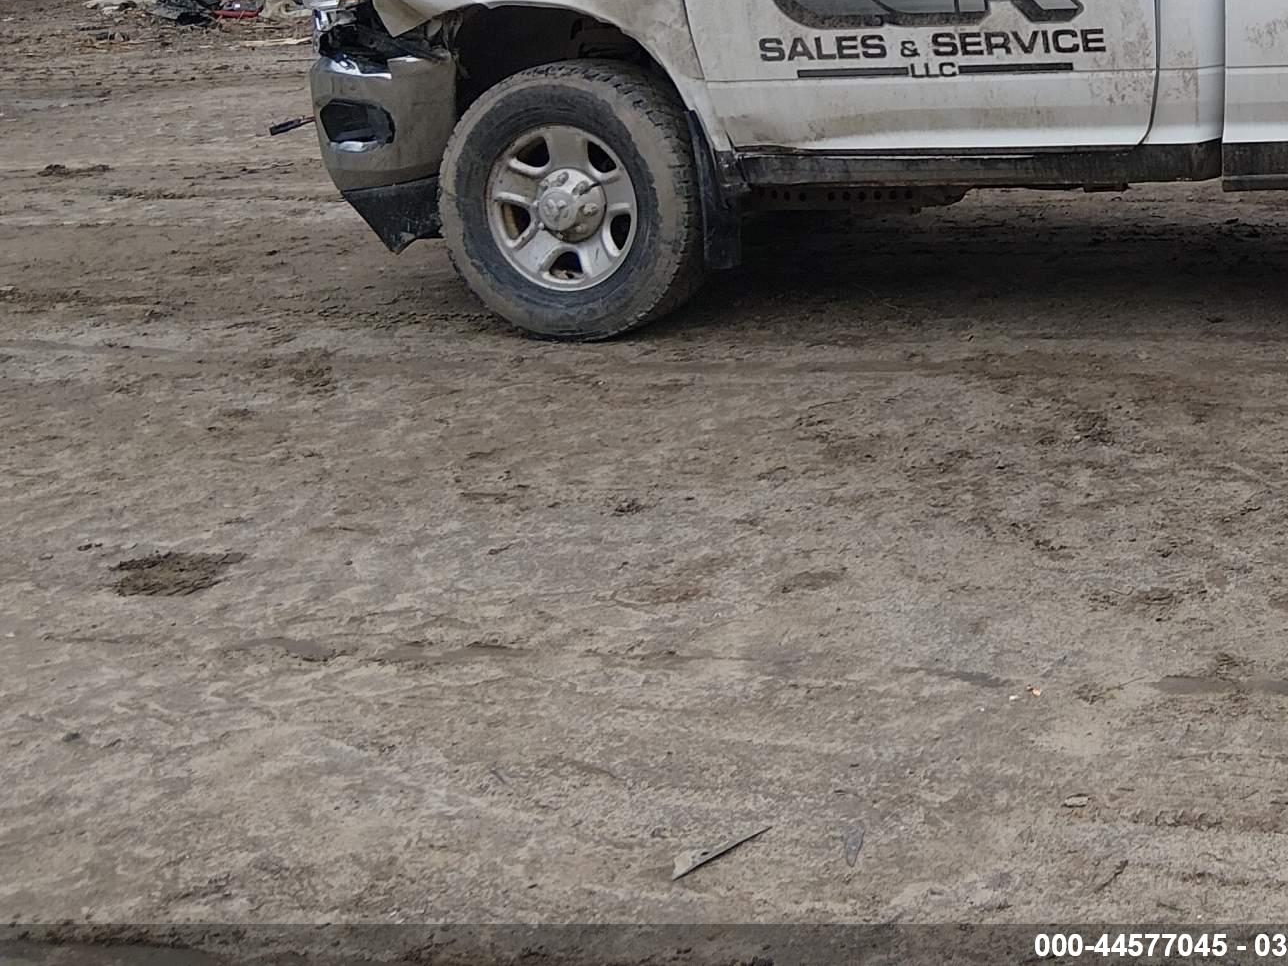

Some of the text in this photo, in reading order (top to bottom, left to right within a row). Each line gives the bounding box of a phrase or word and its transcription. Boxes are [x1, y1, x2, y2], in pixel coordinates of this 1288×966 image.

[759, 28, 1107, 62] SALES & SERVICE
[909, 61, 958, 79] LLC
